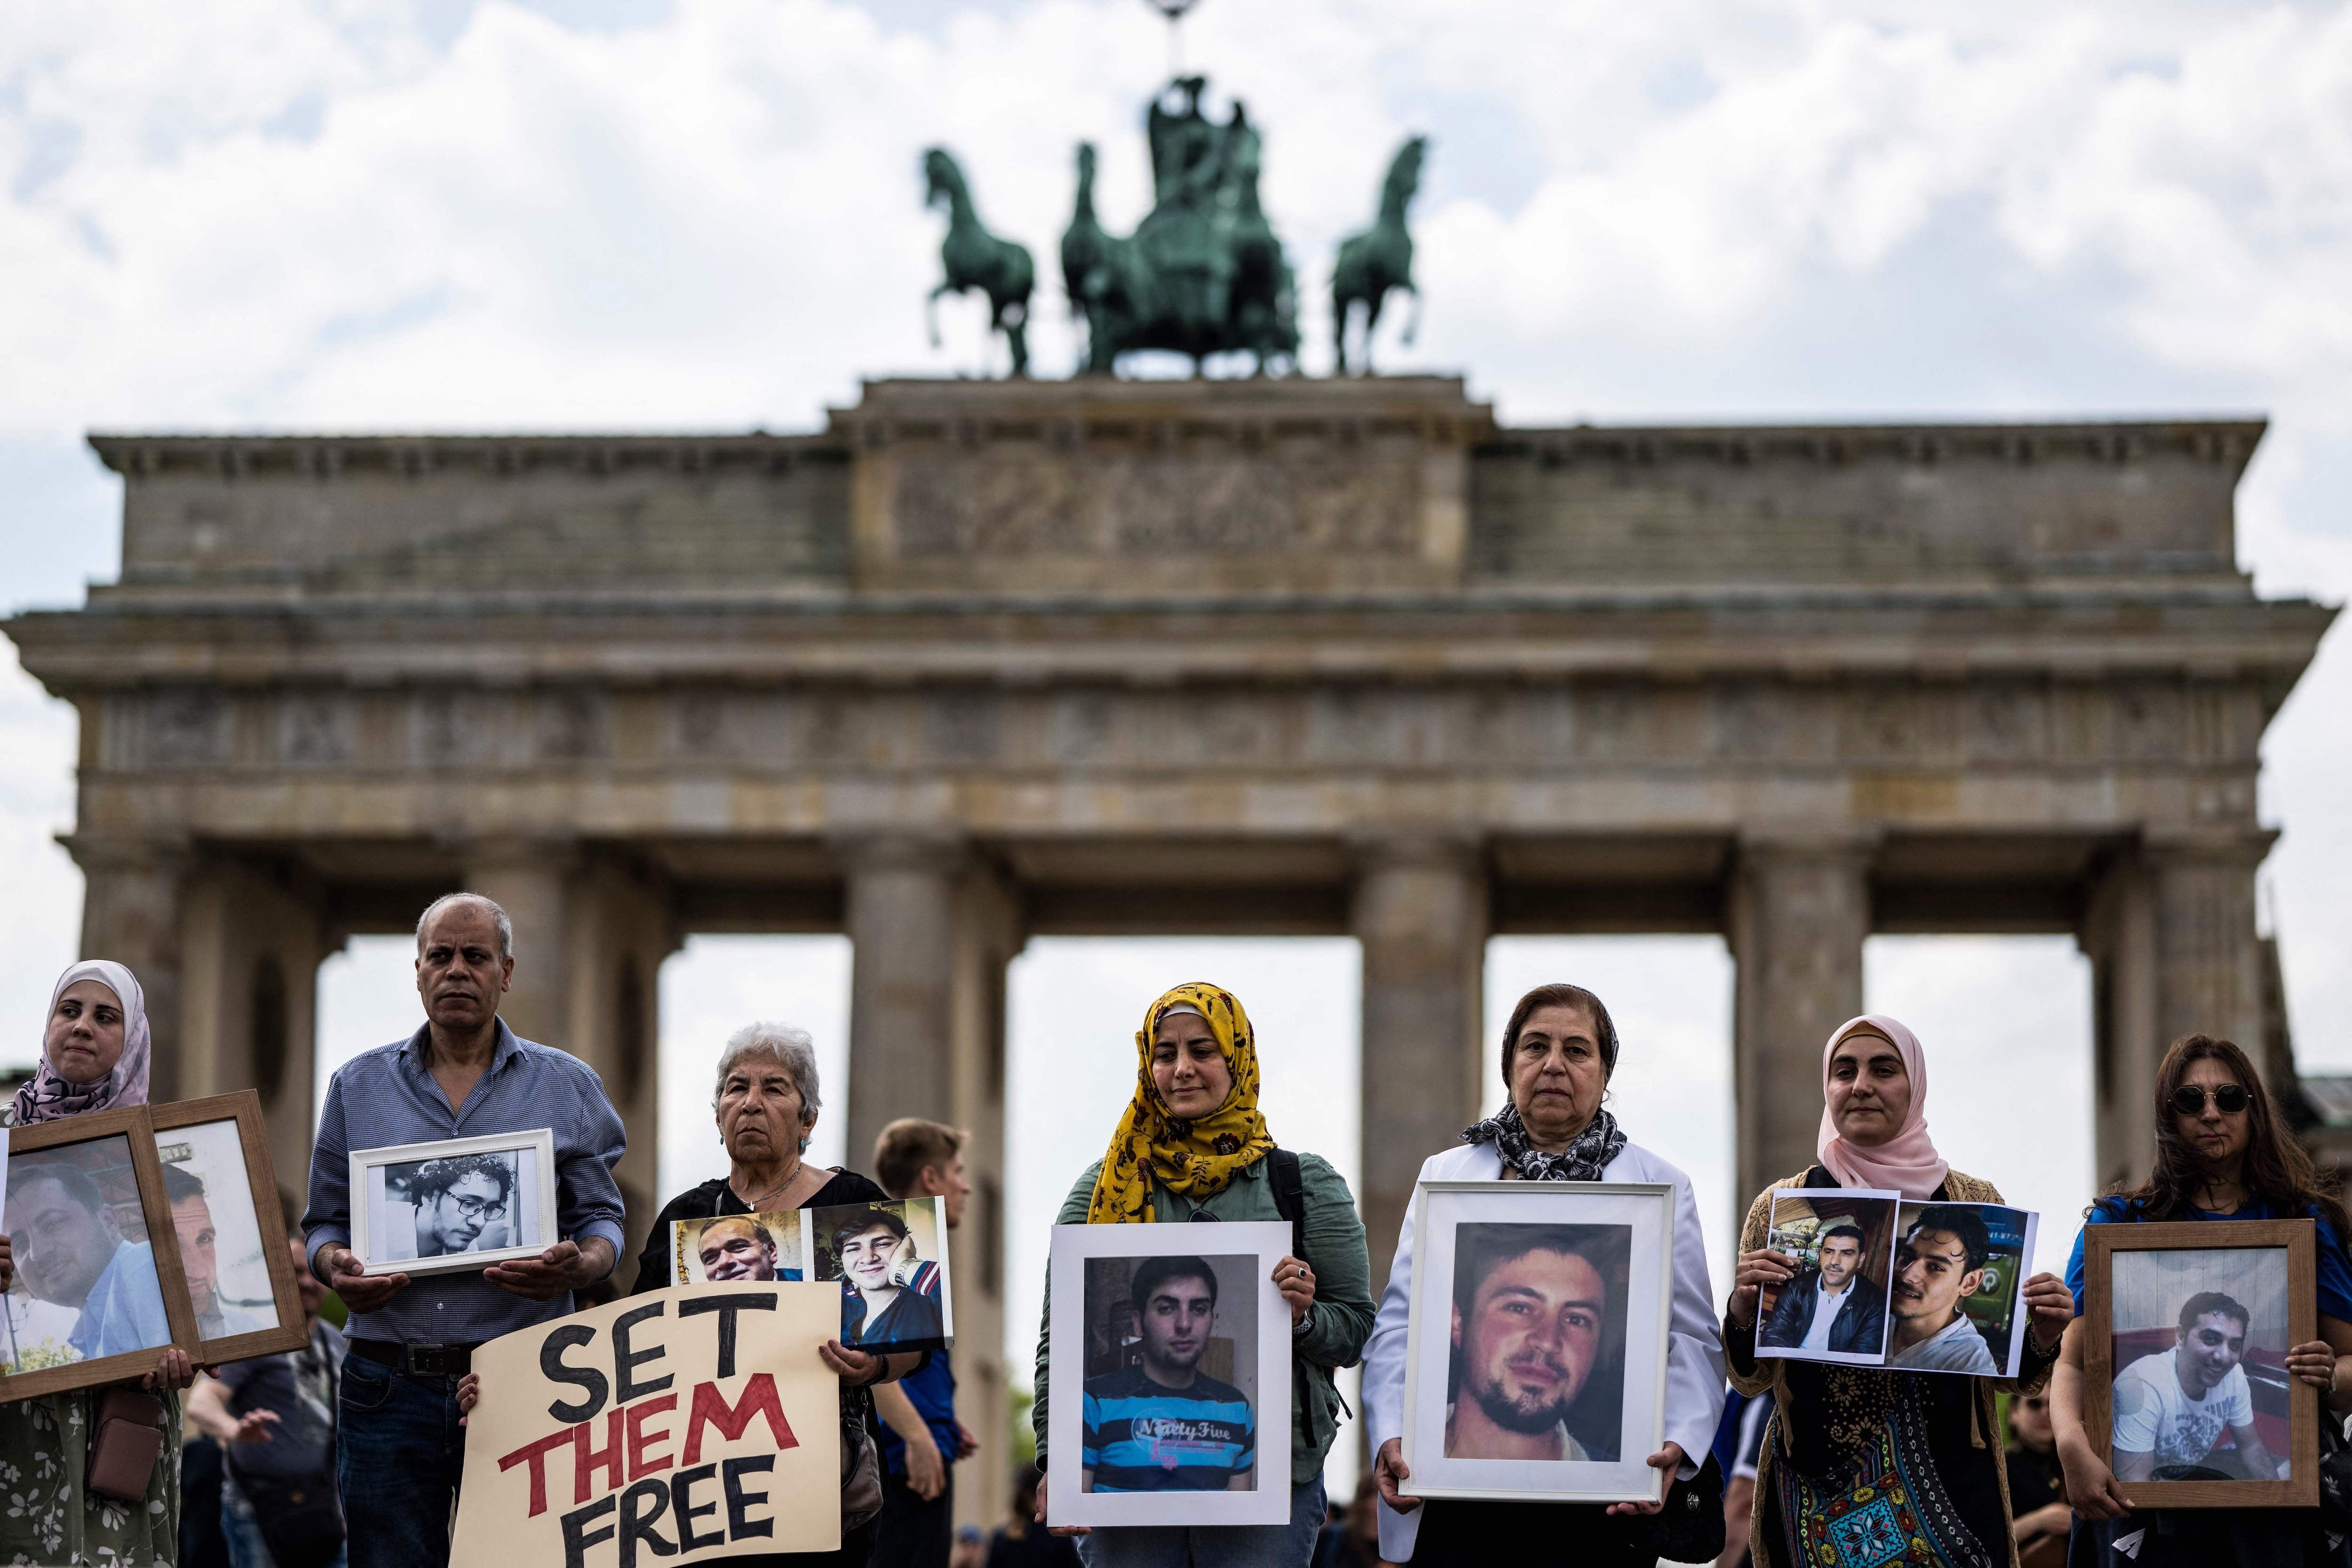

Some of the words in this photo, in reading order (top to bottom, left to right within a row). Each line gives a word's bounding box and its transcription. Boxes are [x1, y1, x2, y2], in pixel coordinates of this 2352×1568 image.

[540, 1293, 778, 1423] SET
[498, 1373, 800, 1518] THEM
[1199, 1422, 1231, 1440] Five
[560, 1454, 775, 1568] FREE
